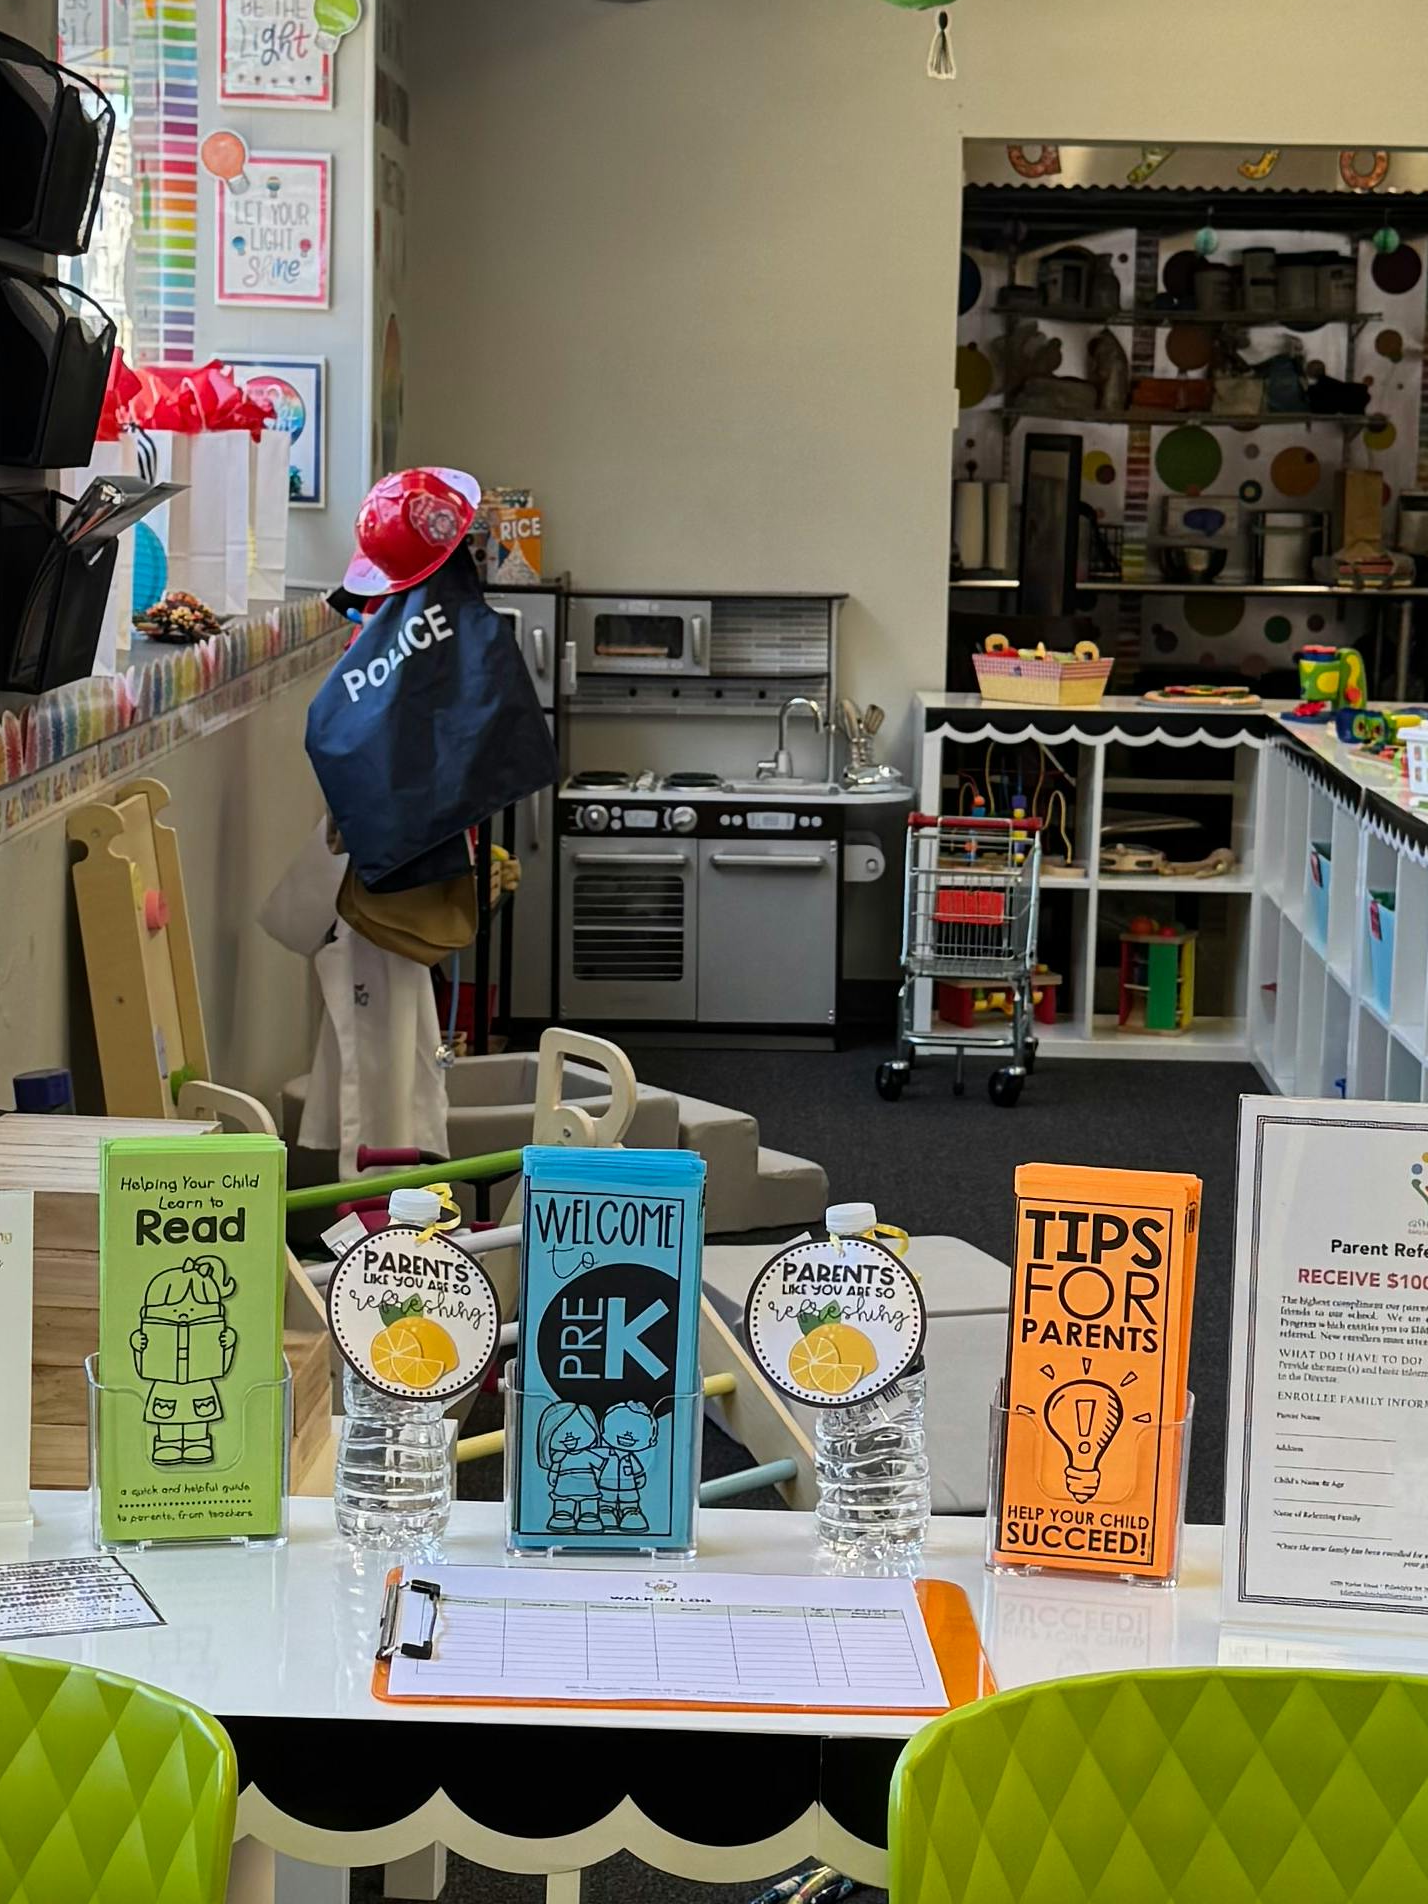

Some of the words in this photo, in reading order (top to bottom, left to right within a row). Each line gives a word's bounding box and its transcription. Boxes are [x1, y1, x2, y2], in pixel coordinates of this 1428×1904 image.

[234, 200, 263, 225] LET
[271, 201, 310, 226] YOUR
[251, 227, 293, 251] LIGHT
[500, 517, 541, 541] RICE
[342, 604, 453, 703] POLICE
[121, 1176, 178, 1193] Helping
[183, 1176, 215, 1190] Your
[222, 1174, 260, 1190] Child
[159, 1196, 203, 1210] Learn
[210, 1197, 223, 1209] to
[136, 1207, 245, 1245] Read
[535, 1197, 677, 1248] WELCOME
[1025, 1209, 1164, 1269] TIPS
[1330, 1239, 1388, 1257] Parent
[364, 1249, 469, 1283] PARENTS
[547, 1243, 600, 1279] to
[782, 1262, 895, 1285] PARENTS
[364, 1273, 389, 1285] LIKE
[393, 1275, 424, 1288] YOU
[427, 1279, 449, 1292] ARE
[452, 1283, 471, 1295] SO
[1298, 1268, 1380, 1287] RECEIVE
[782, 1284, 807, 1295] LIKE
[811, 1284, 842, 1296] YOU
[846, 1286, 870, 1297] ARE
[875, 1287, 895, 1299] SO
[1024, 1262, 1159, 1325] FOR
[349, 1289, 486, 1330] refreshing
[768, 1297, 910, 1332] refreshing
[559, 1297, 603, 1379] PRE
[605, 1297, 670, 1381] K
[1022, 1317, 1158, 1354] PARENTS
[1279, 1349, 1315, 1359] WHAT
[1319, 1351, 1336, 1361] DO
[1347, 1353, 1377, 1363] HAVE
[1382, 1355, 1398, 1364] TO
[1277, 1391, 1337, 1403] ENROLLEE
[1340, 1395, 1384, 1406] FAMILY
[131, 1483, 158, 1497] quick
[161, 1483, 180, 1494] and
[184, 1482, 218, 1494] helpful
[222, 1481, 251, 1493] guide
[117, 1514, 127, 1522] to
[178, 1509, 204, 1519] from
[209, 1508, 253, 1519] teachers
[1007, 1505, 1044, 1520] HELP
[1049, 1508, 1095, 1525] YOUR
[1100, 1513, 1149, 1530] CHILD
[1006, 1521, 1147, 1556] SUCCEED!
